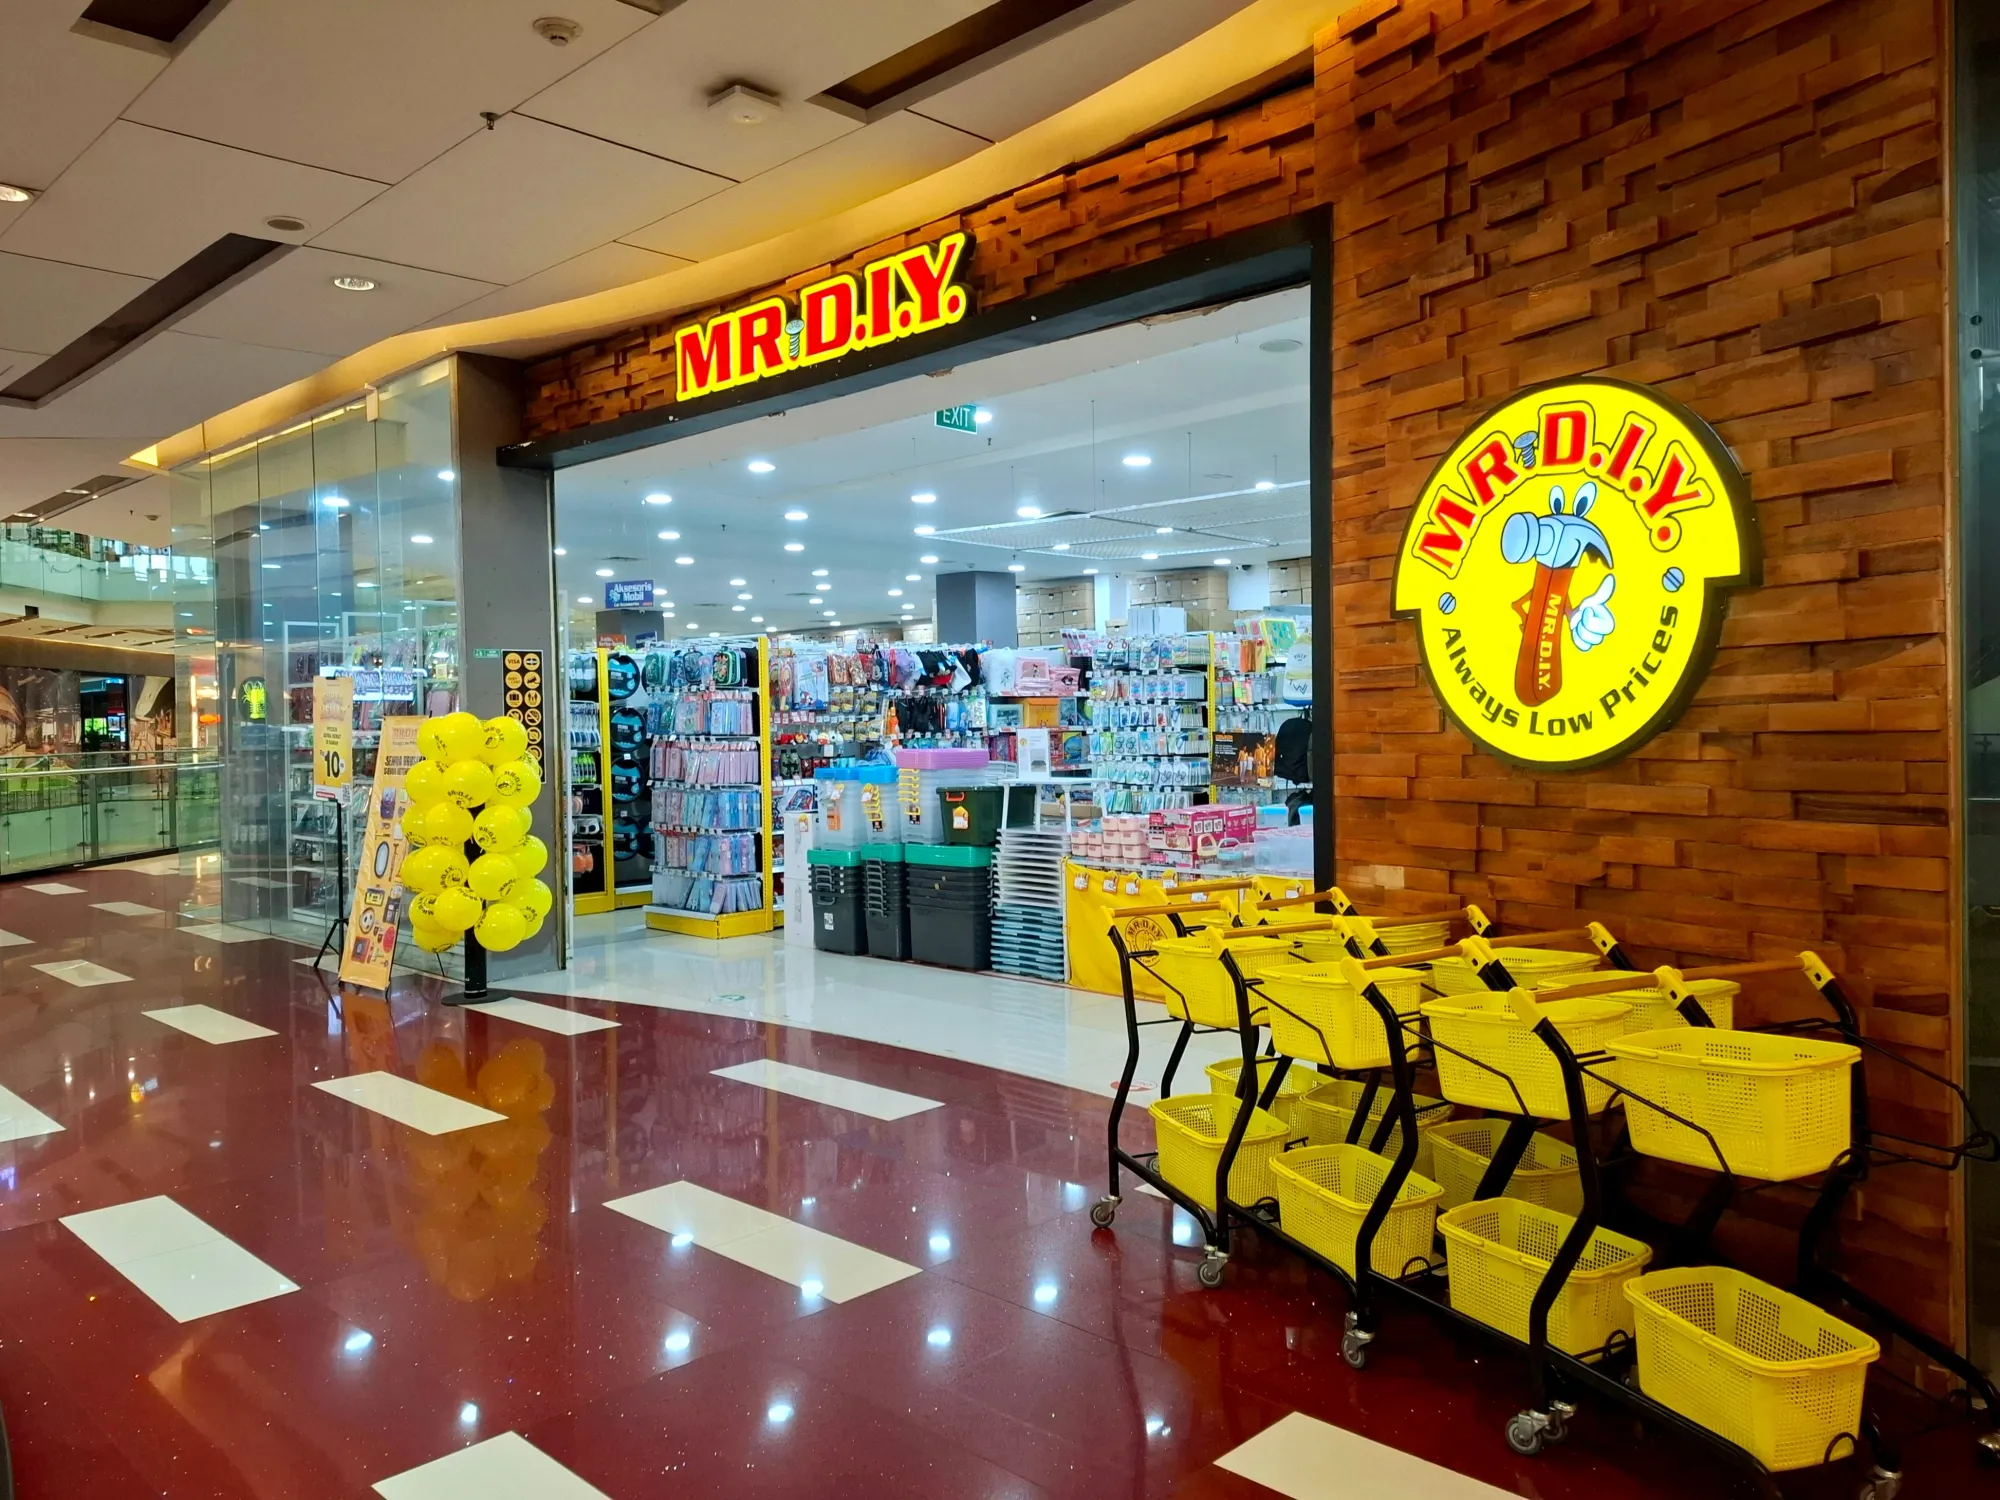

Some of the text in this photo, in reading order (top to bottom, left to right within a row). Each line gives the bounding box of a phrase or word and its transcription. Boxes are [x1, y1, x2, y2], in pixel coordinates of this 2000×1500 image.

[679, 241, 962, 394] MR D.I.Y.
[943, 406, 970, 428] EXIT
[1417, 409, 1704, 571] MR D.I.Y.
[613, 582, 652, 593] Aksesoris
[623, 592, 644, 602] Mobil
[1441, 605, 1679, 737] Always Low Prices
[324, 750, 340, 778] 10
